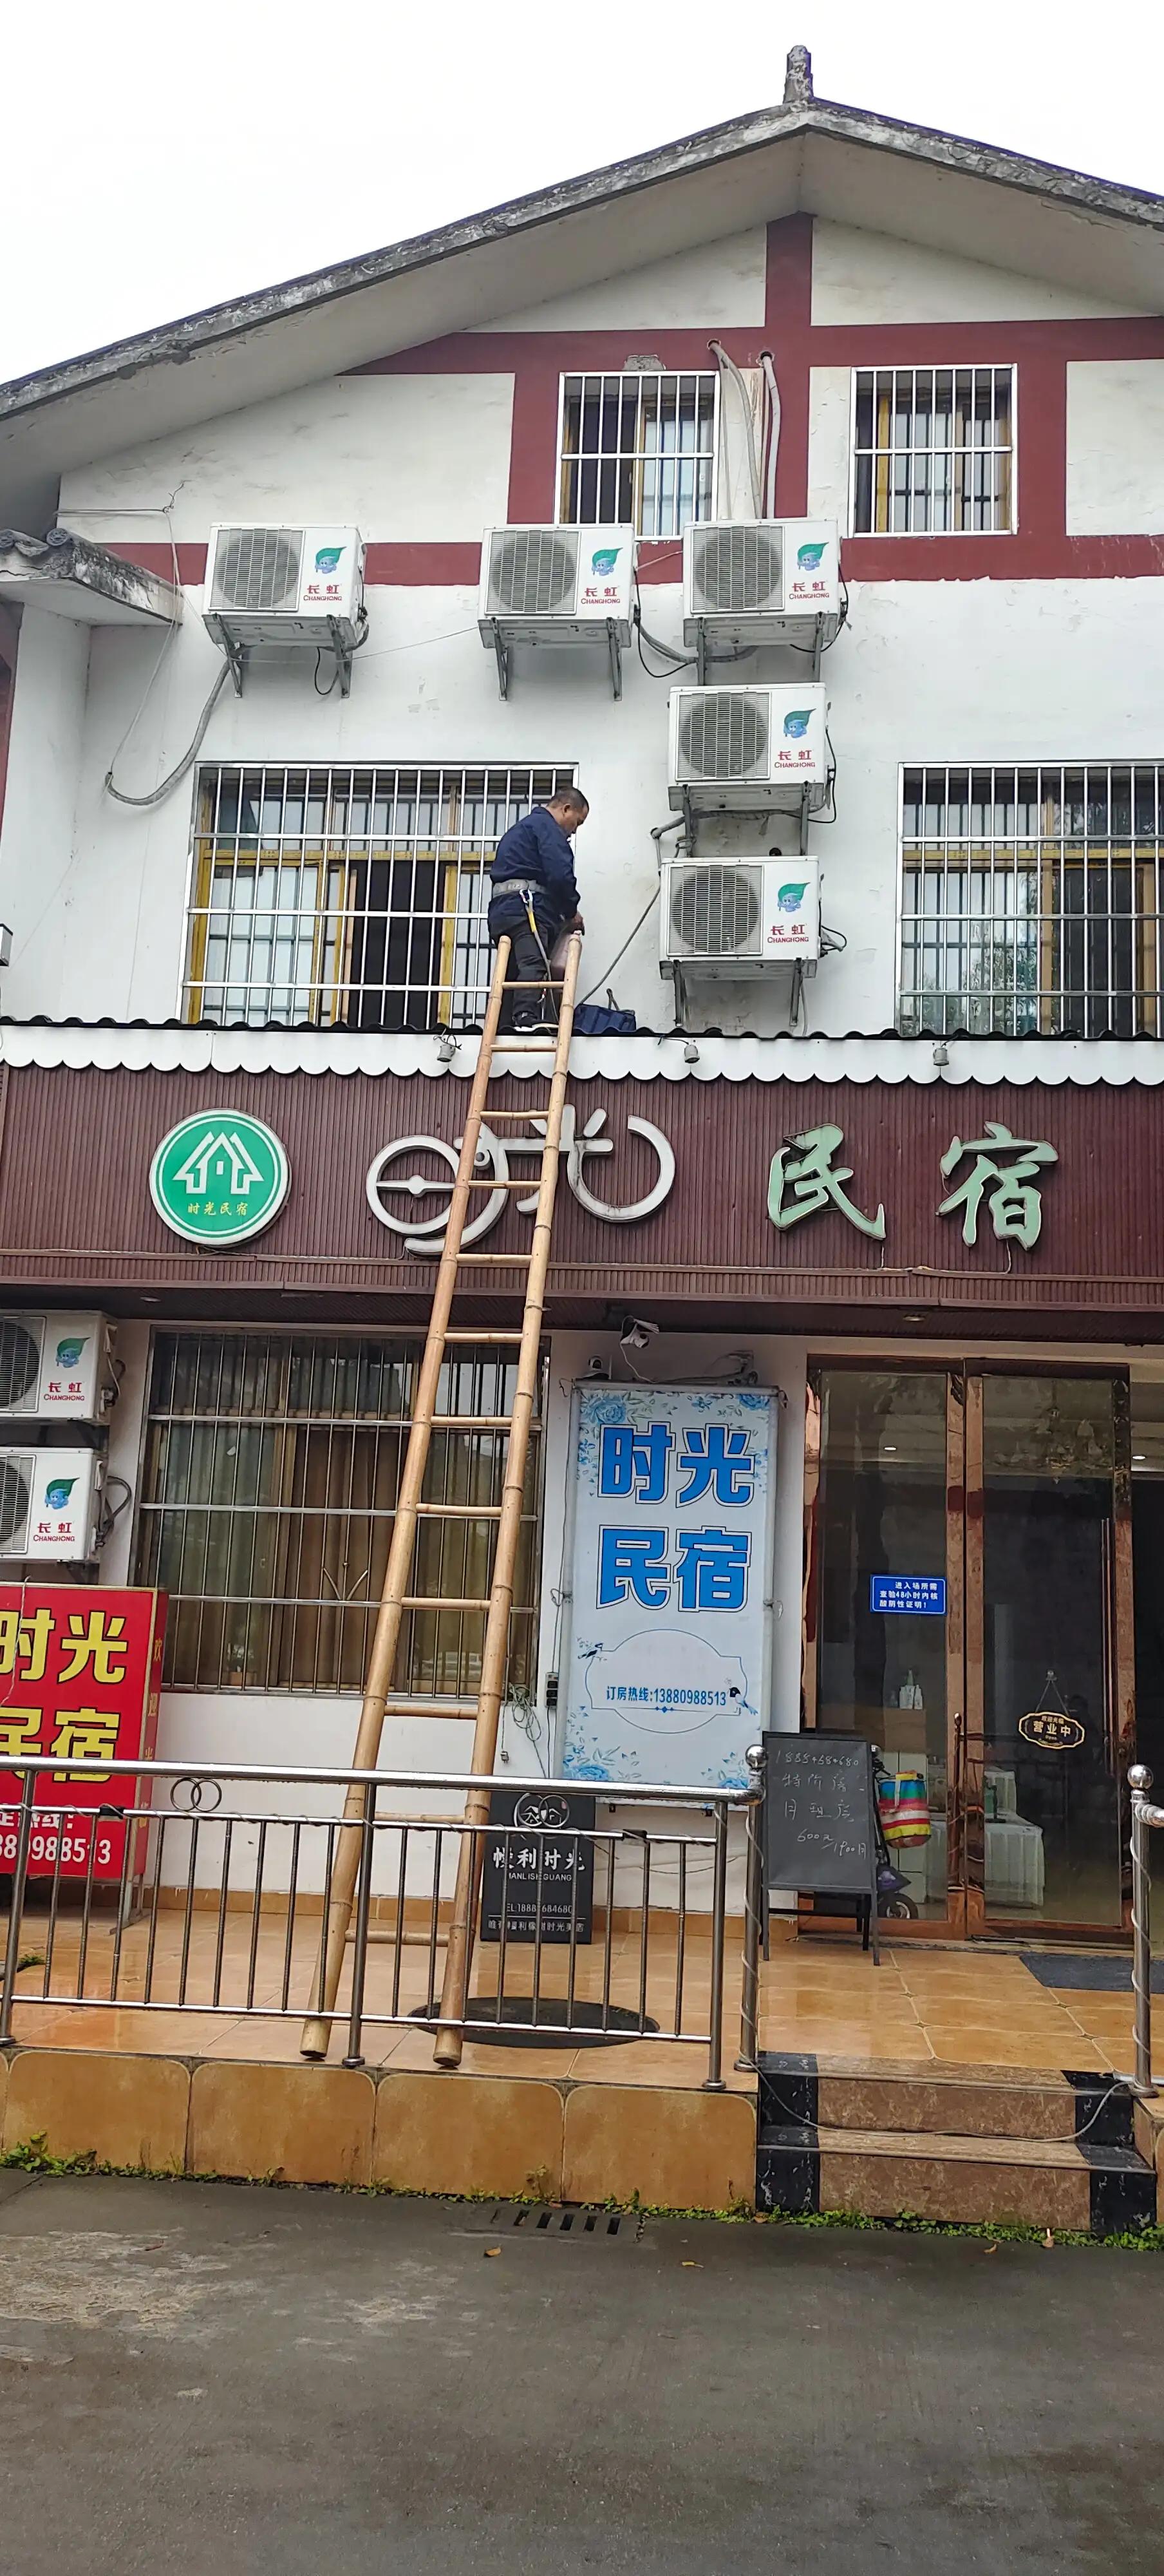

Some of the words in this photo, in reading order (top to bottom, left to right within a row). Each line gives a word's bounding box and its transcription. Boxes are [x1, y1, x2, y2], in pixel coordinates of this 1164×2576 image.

[306, 583, 340, 594] 长虹
[584, 587, 618, 598] 长虹
[791, 581, 826, 592] 长虹
[777, 750, 812, 761] 长虹
[770, 924, 805, 936] 长虹
[187, 1201, 249, 1217] 时光民宿
[47, 1381, 83, 1393] 长虹
[598, 1421, 756, 1508] 时光
[37, 1522, 73, 1534] 长虹
[33, 1534, 75, 1542] CHANGHONG
[596, 1524, 753, 1613] 民宿
[895, 1581, 938, 1591] 进入场所需
[0, 1607, 127, 1685] 时光
[606, 1685, 726, 1706] 订房热线:13880988513
[1033, 1720, 1071, 1738] 营业中
[0, 1833, 111, 1864] 898853
